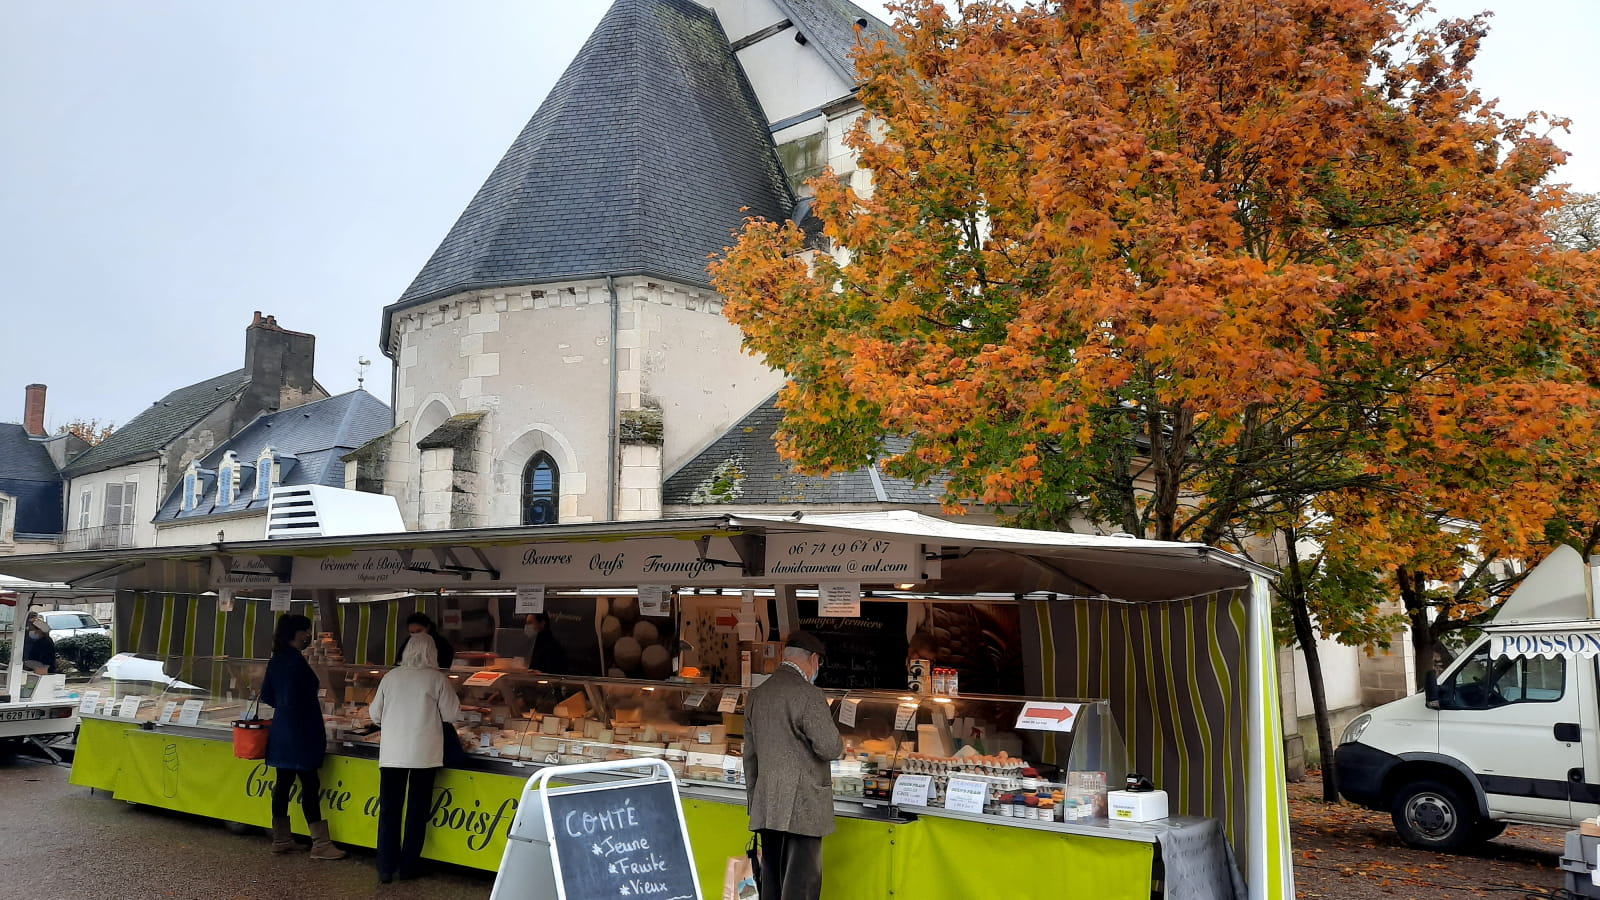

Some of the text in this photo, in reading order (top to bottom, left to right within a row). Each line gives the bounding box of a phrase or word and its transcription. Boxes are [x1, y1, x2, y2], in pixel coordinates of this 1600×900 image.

[788, 541, 808, 556] 06
[810, 542, 826, 555] 74
[830, 543, 847, 557] 19
[872, 540, 890, 554] 87
[362, 556, 372, 571] de
[522, 548, 717, 579] Beurres Oeufs Fromages
[846, 559, 858, 574] @
[861, 558, 908, 573] aol.com
[6, 711, 23, 721] 629
[565, 797, 639, 837] COMTÉ
[600, 835, 650, 858] Jeune
[629, 878, 669, 895] Vieux
